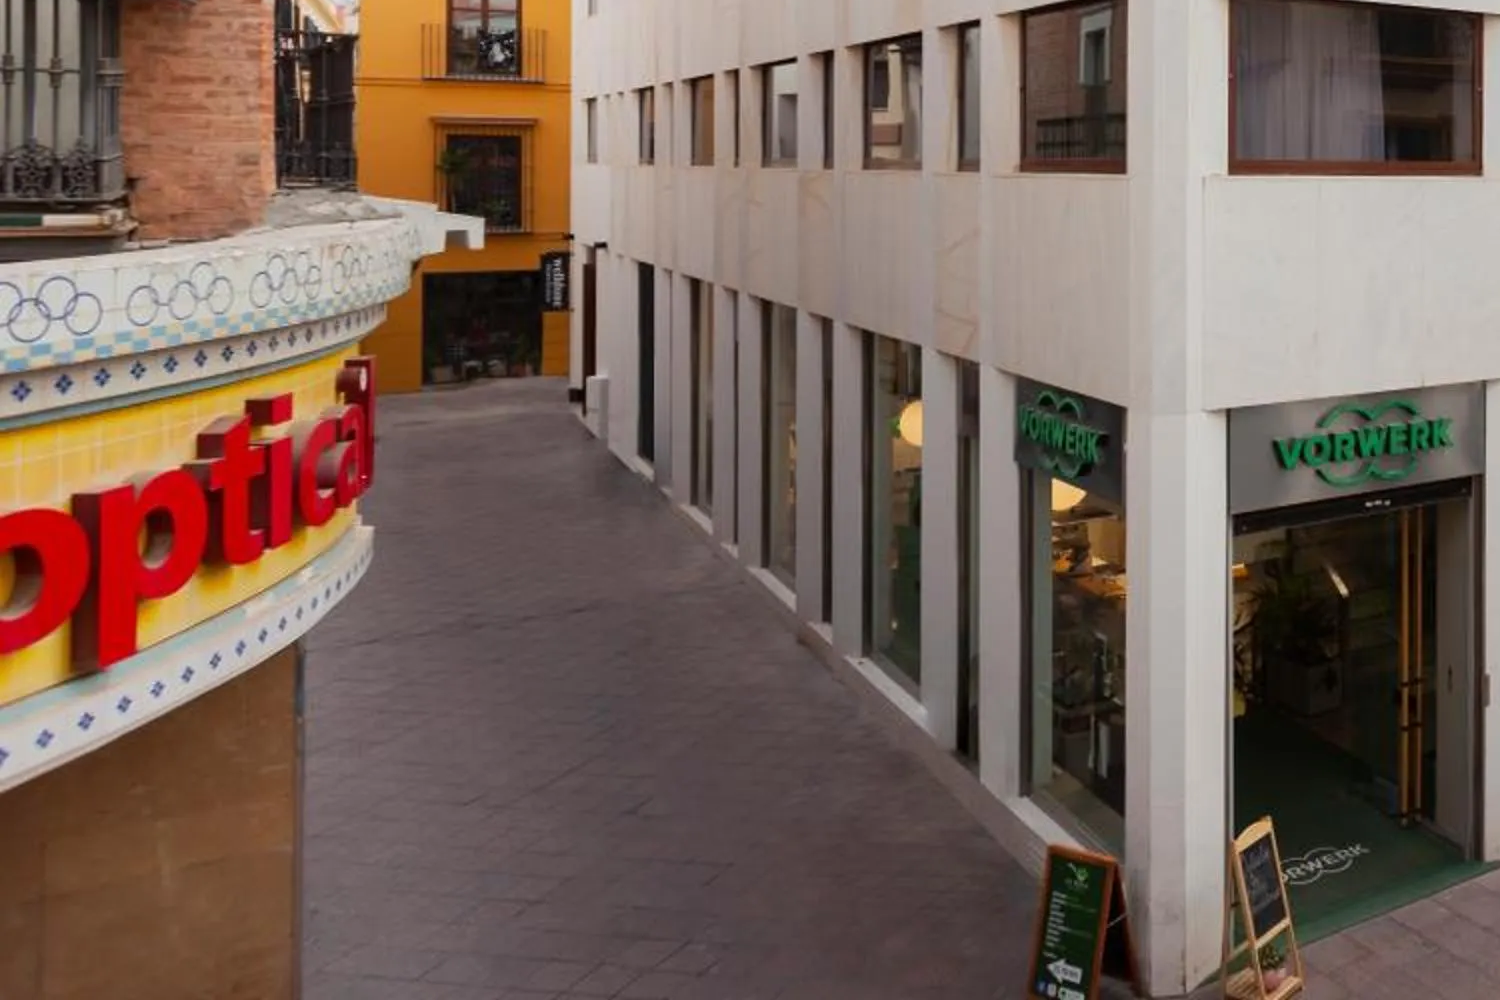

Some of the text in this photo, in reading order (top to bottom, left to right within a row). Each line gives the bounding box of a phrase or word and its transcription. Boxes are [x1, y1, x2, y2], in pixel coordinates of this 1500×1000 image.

[1020, 404, 1104, 463] VORWERK
[1273, 418, 1453, 470] VORWERK
[1281, 843, 1370, 882] ORWERK
